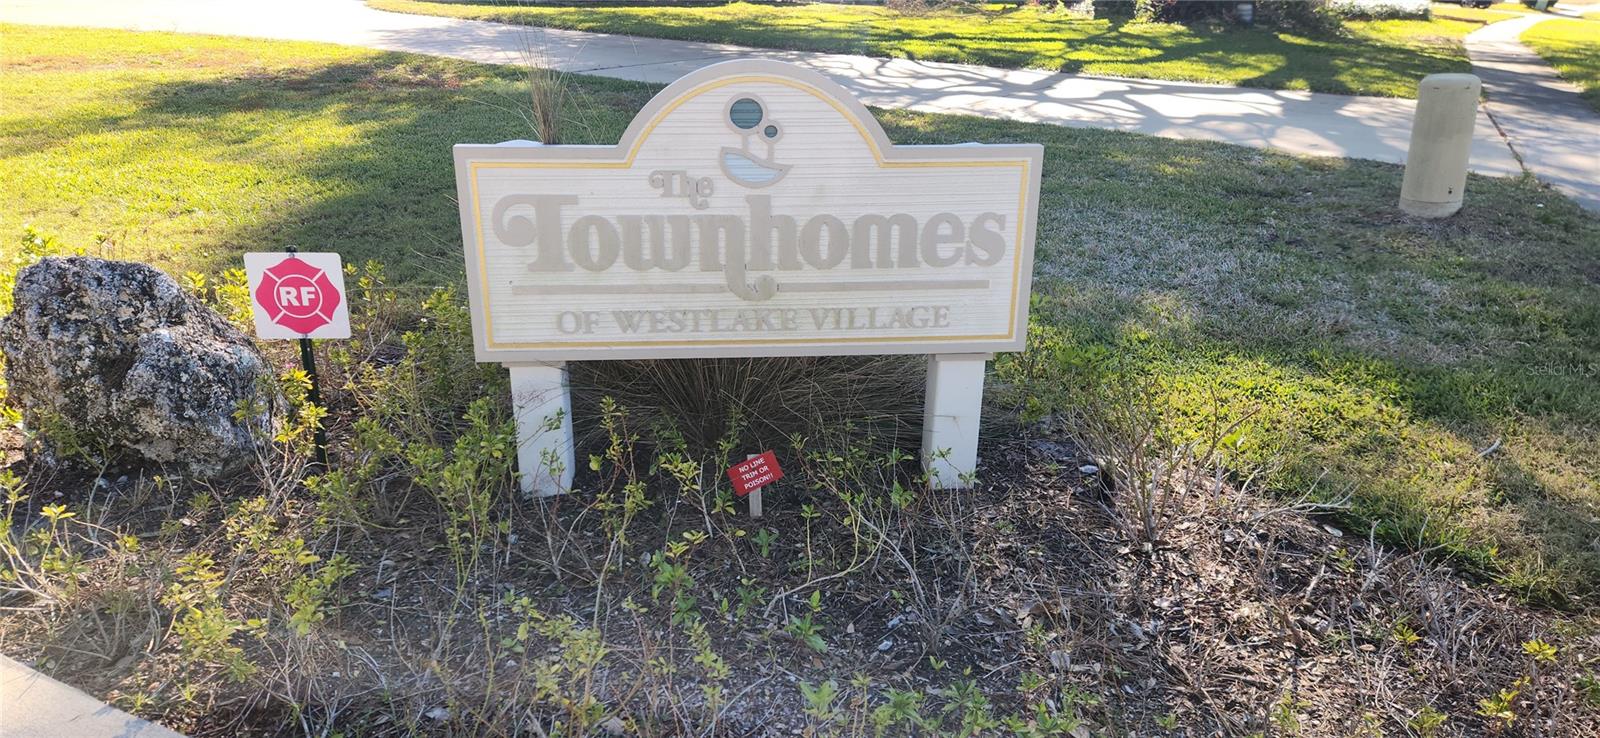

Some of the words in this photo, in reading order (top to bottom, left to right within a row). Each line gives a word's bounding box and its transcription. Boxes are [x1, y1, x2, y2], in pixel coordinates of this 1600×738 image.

[648, 170, 714, 210] The
[492, 193, 1007, 301] Townhomes
[279, 286, 316, 307] RF
[556, 310, 600, 335] OF
[611, 308, 798, 334] WESTLAKE
[806, 305, 951, 331] VILLAGE
[738, 465, 750, 473] NO
[750, 457, 766, 469] LINE
[741, 470, 759, 481] TRIM
[758, 465, 769, 474] OR
[744, 472, 774, 490] POISON!!
